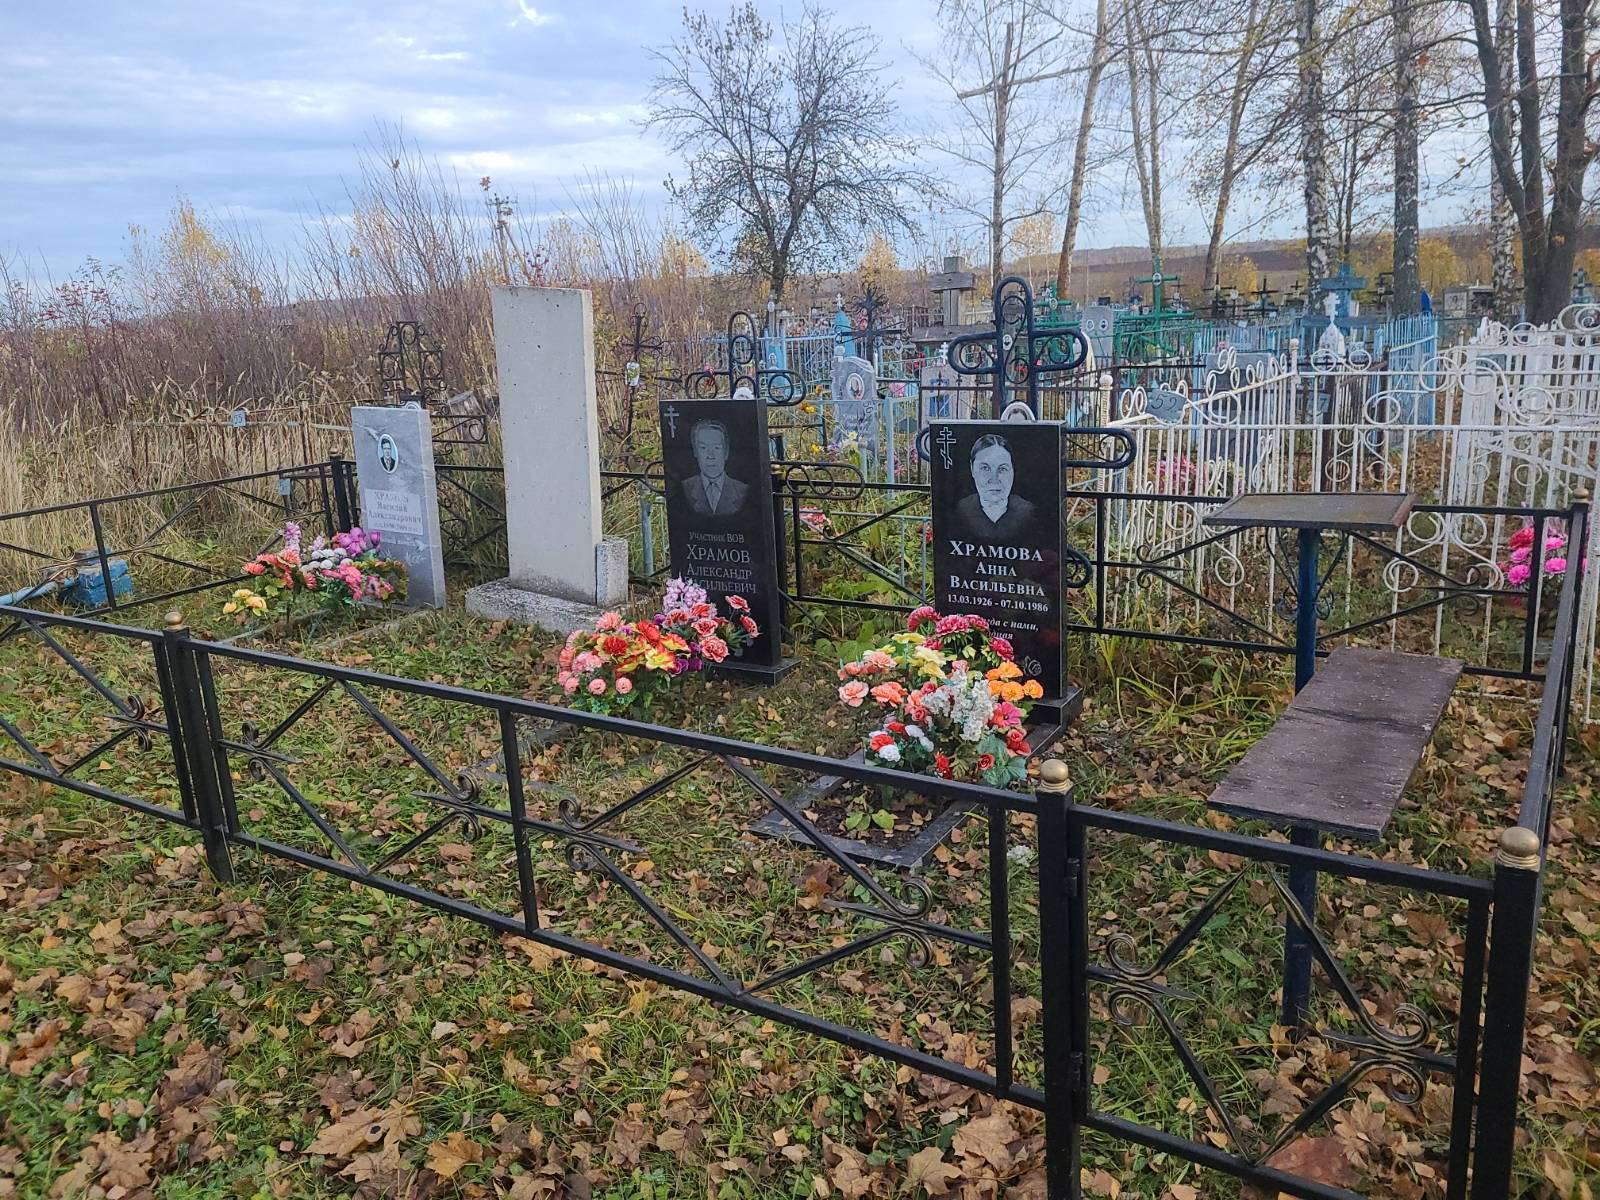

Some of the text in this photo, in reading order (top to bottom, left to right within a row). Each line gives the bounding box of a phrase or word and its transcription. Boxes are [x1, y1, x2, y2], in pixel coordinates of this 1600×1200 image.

[727, 533, 745, 543] ВОВ
[947, 594, 993, 607] 13.03.1926
[1000, 599, 1049, 612] 07.10.1986
[1010, 621, 1039, 632] нами,
